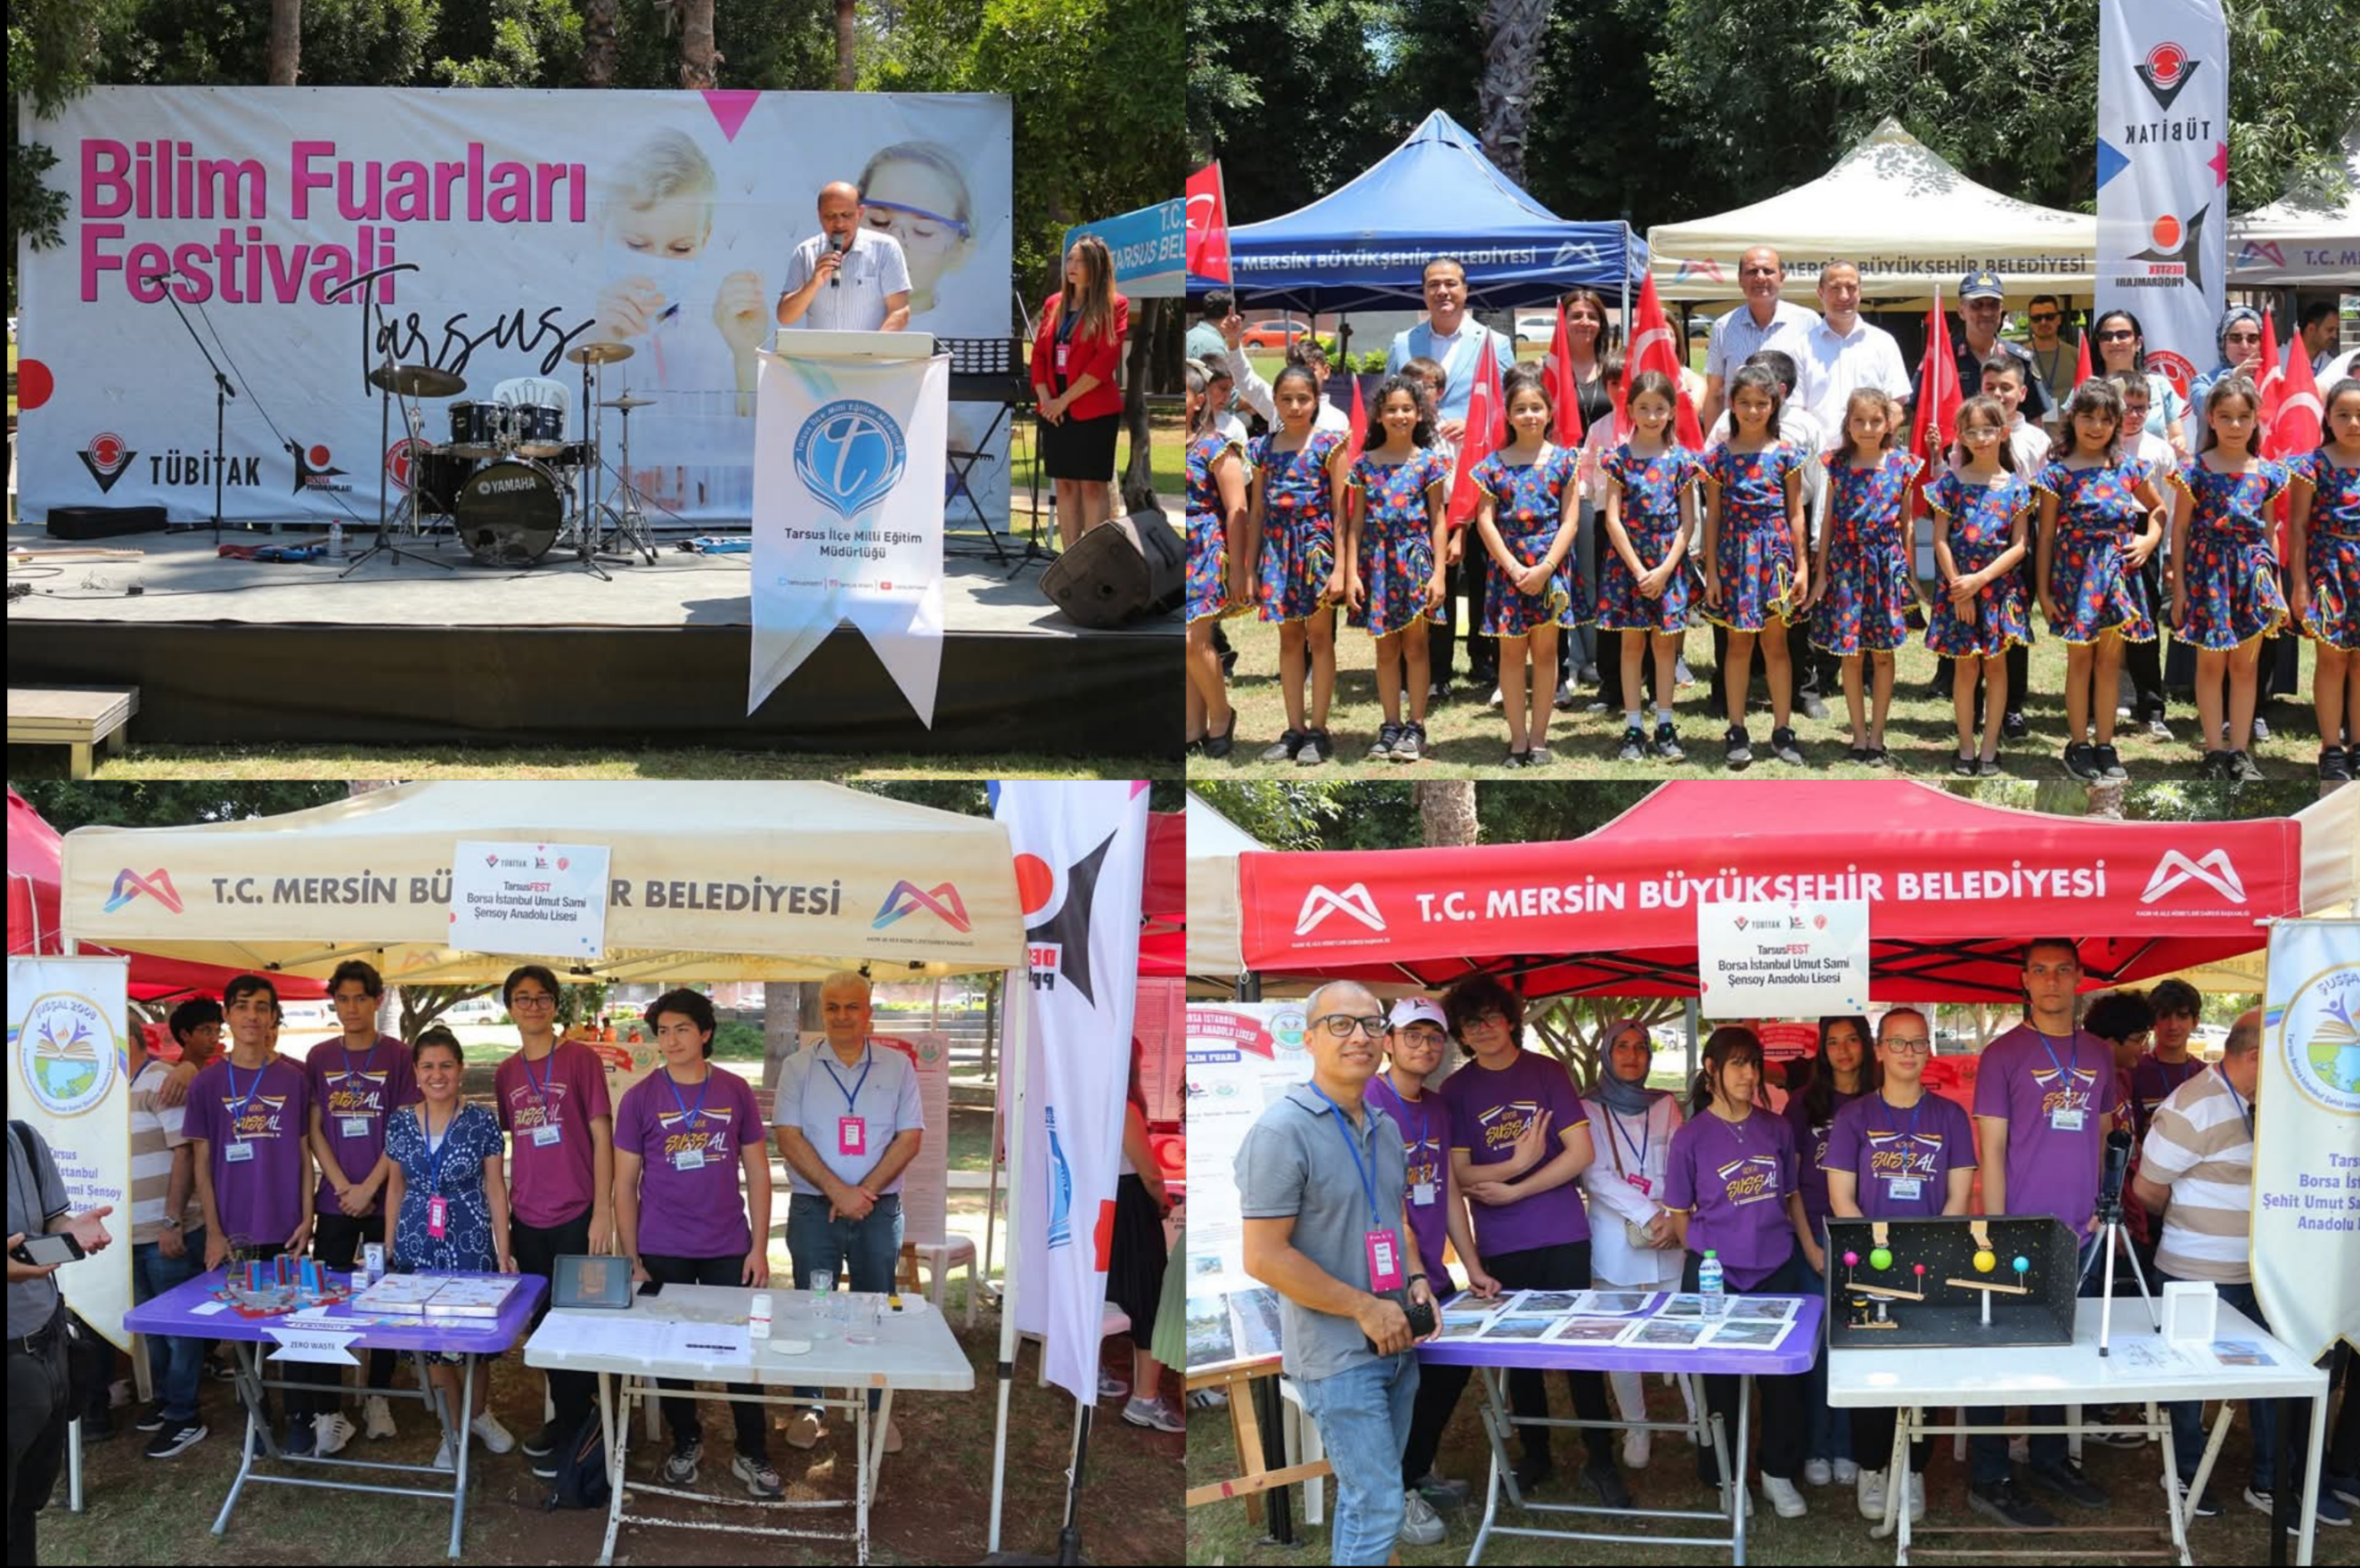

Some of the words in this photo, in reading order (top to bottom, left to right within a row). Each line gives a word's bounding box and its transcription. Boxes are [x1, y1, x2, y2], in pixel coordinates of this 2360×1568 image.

[80, 139, 266, 219] Bilim
[290, 140, 586, 223] Fuarları
[1159, 202, 1185, 232] T.C.
[80, 224, 396, 305] Festivali
[1243, 251, 1311, 271] MERSİN
[1317, 247, 1433, 270] BÜYÜKŞEHİR
[2304, 249, 2335, 265] T.C.
[1858, 255, 1978, 279] BÜYÜKŞEHİR
[1986, 253, 2086, 274] BELEDİYESİ
[325, 264, 596, 396] Tarsus
[150, 448, 261, 486] TÜBİTAK
[491, 477, 536, 493] YAMAHA
[785, 527, 826, 540] Tarsus
[829, 527, 851, 542] İlçe
[854, 531, 881, 543] Milli
[884, 532, 923, 545] Eğitim
[820, 545, 886, 561] Müdürlüğü
[212, 877, 263, 903] T.C.
[273, 869, 396, 905] MERSİN
[503, 881, 551, 892] TarsusFEST
[1416, 891, 1476, 923] T.C.
[1485, 874, 1626, 919] MERSİN
[1897, 859, 2107, 901] BELEDİYESİ
[468, 893, 494, 903] Borsa
[495, 892, 533, 906] İstanbul
[535, 895, 559, 907] Umut
[562, 897, 586, 908] Sami
[646, 876, 840, 917] BELEDİYESİ
[474, 907, 508, 920] Şensoy
[510, 908, 549, 920] Anadolu
[551, 911, 577, 921] Lisesi
[1757, 943, 1810, 956] TarsusFEST
[1718, 960, 1748, 971] Borsa
[1750, 957, 1792, 970] İstanbul
[1793, 959, 1821, 969] Umut
[1823, 957, 1850, 968] Sami
[1727, 973, 1766, 988] Şensoy
[1768, 972, 1809, 984] Anadolu
[1812, 972, 1841, 984] Lisesi
[2329, 1153, 2360, 1168] Tars
[2299, 1173, 2340, 1188] Borsa
[66, 1185, 84, 1196] ami
[2263, 1193, 2299, 1210] Şehit
[2305, 1195, 2344, 1210] Umut
[2298, 1215, 2354, 1231] Anadolu
[290, 1341, 310, 1349] ZERO
[311, 1342, 336, 1351] WASTE
